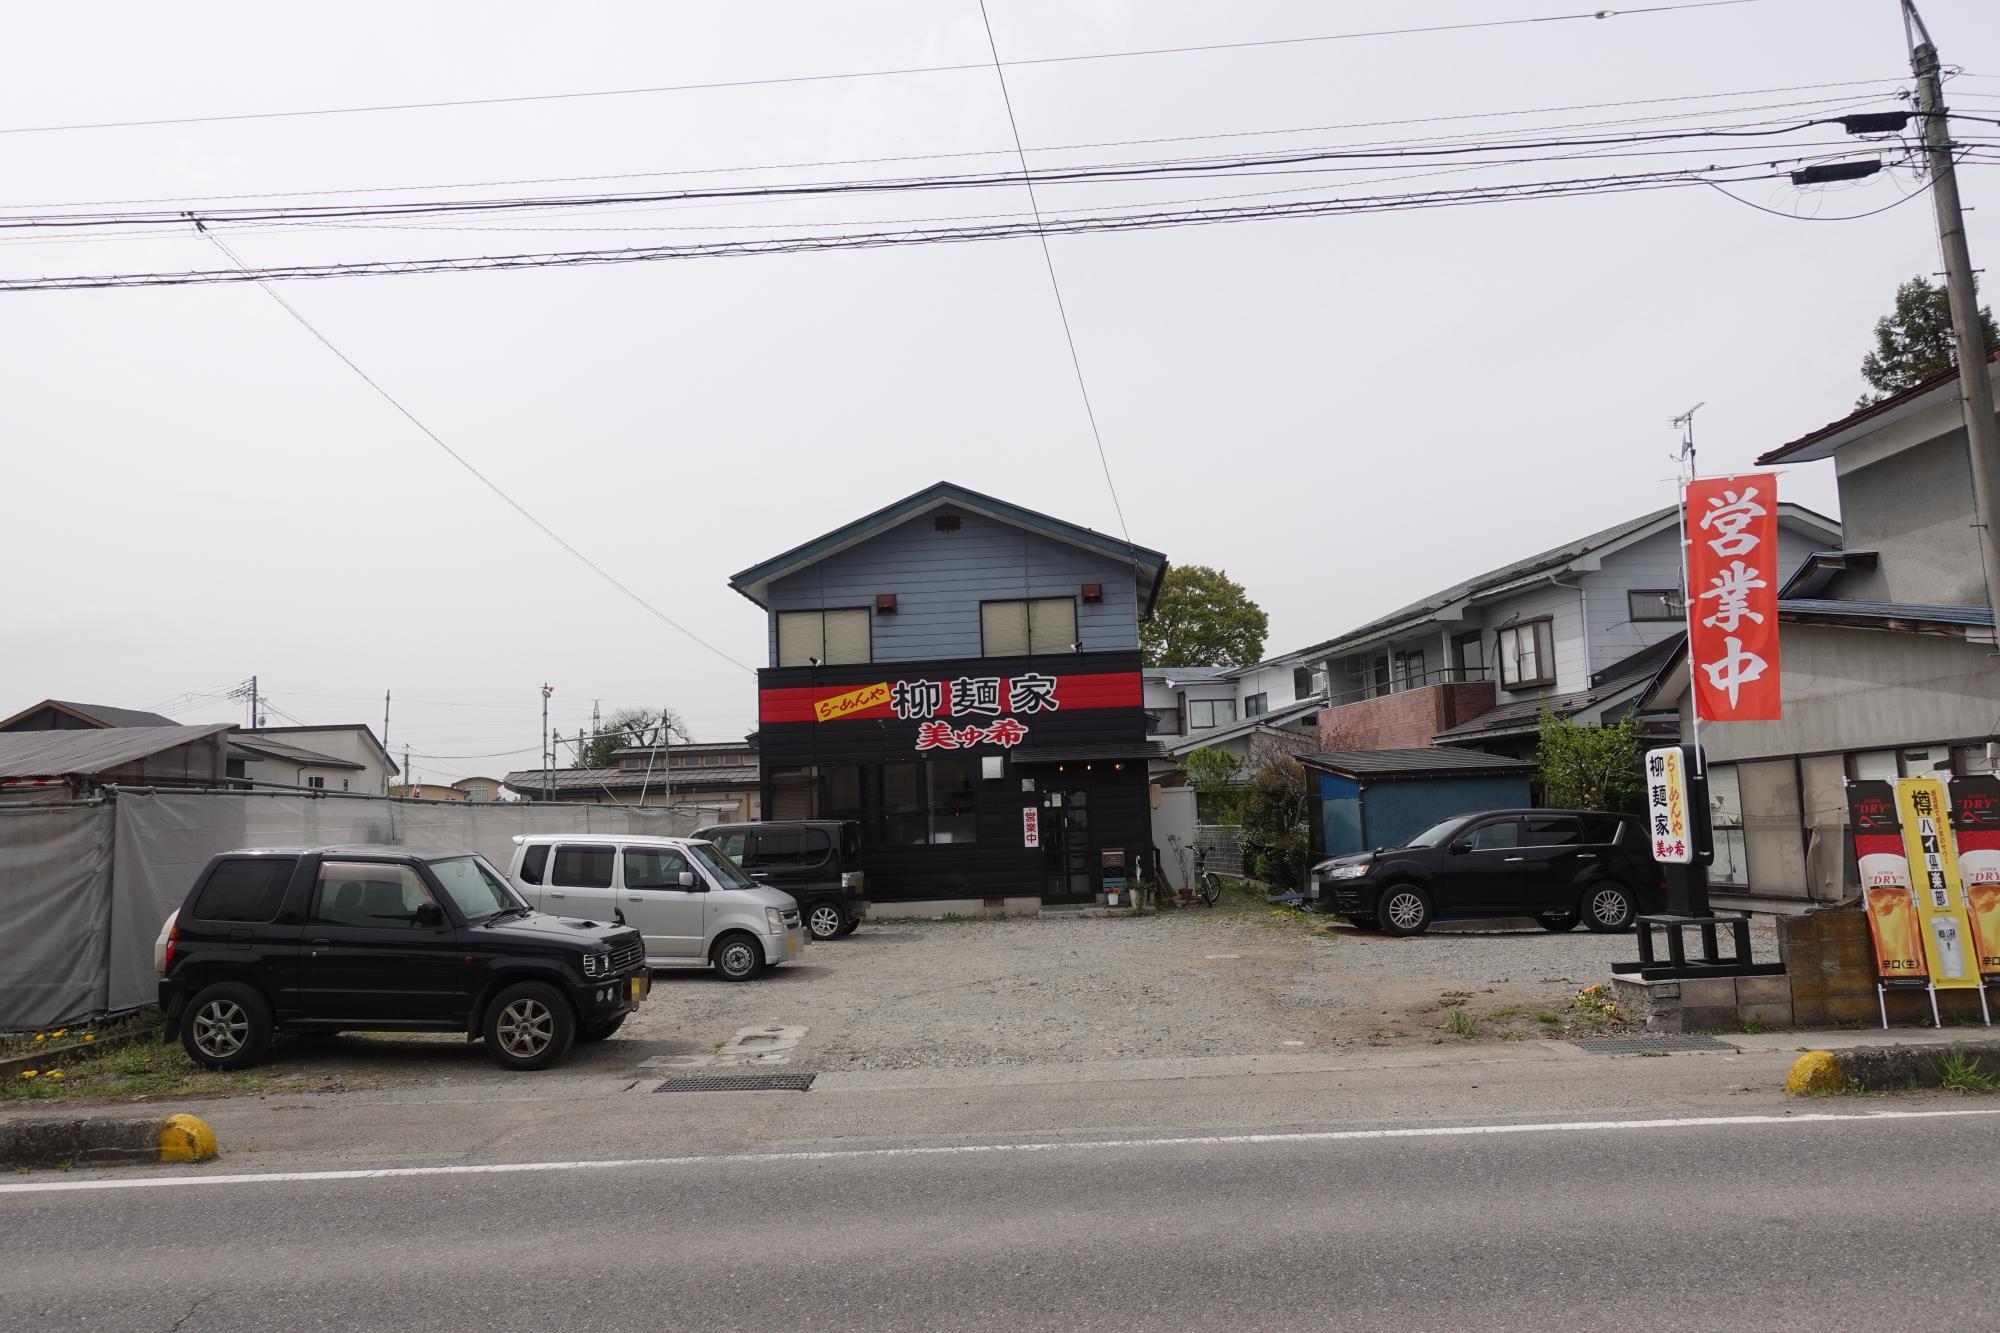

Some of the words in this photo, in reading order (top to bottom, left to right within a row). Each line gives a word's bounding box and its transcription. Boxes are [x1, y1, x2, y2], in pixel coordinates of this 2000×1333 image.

[1700, 487, 1768, 710] 営業中
[819, 687, 886, 717] らーめんや
[915, 718, 1029, 750] 美ゆ希
[1667, 754, 1683, 836] らーめんや
[1025, 811, 1037, 843] 営業中
[1656, 840, 1685, 858] 美ゆ希
